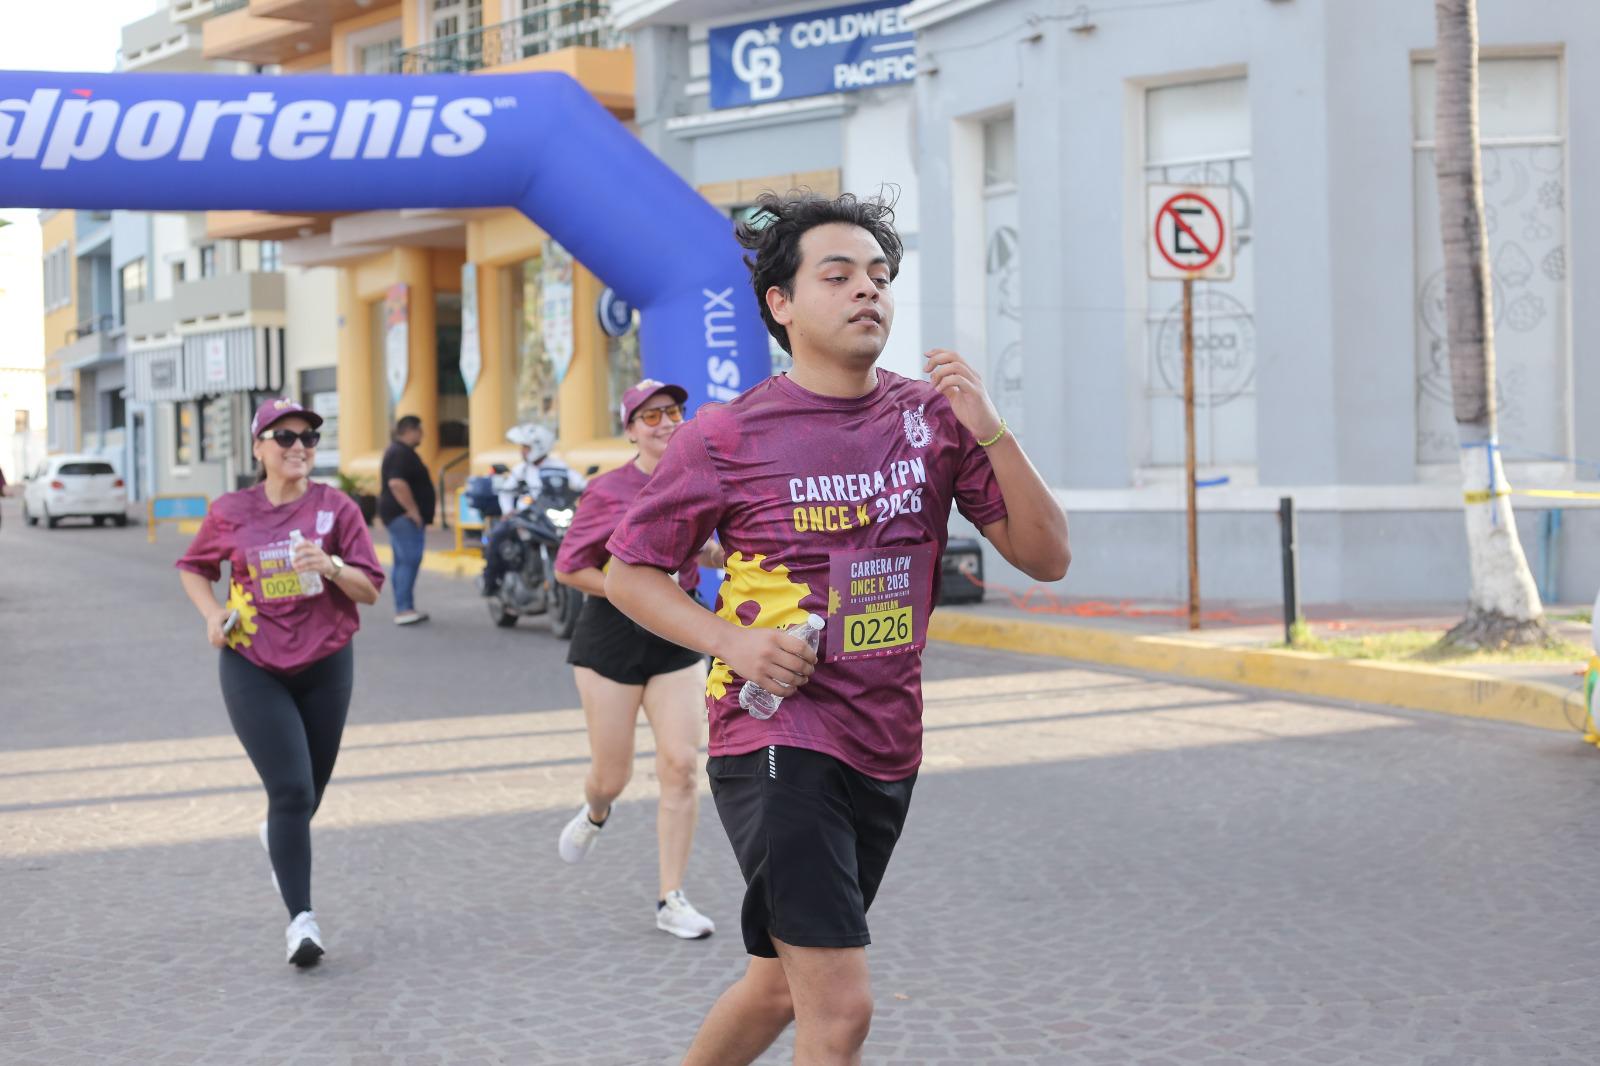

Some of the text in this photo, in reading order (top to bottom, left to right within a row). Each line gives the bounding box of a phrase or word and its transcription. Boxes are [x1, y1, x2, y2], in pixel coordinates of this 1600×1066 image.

[834, 54, 916, 89] PACIFIC
[789, 456, 926, 503] CARRERA IPN
[793, 487, 923, 533] ONCE K 2026
[850, 556, 912, 578] CARRERA IPN
[850, 572, 909, 596] ONCE K 2026
[265, 578, 301, 596] 002
[850, 613, 909, 647] 0226
